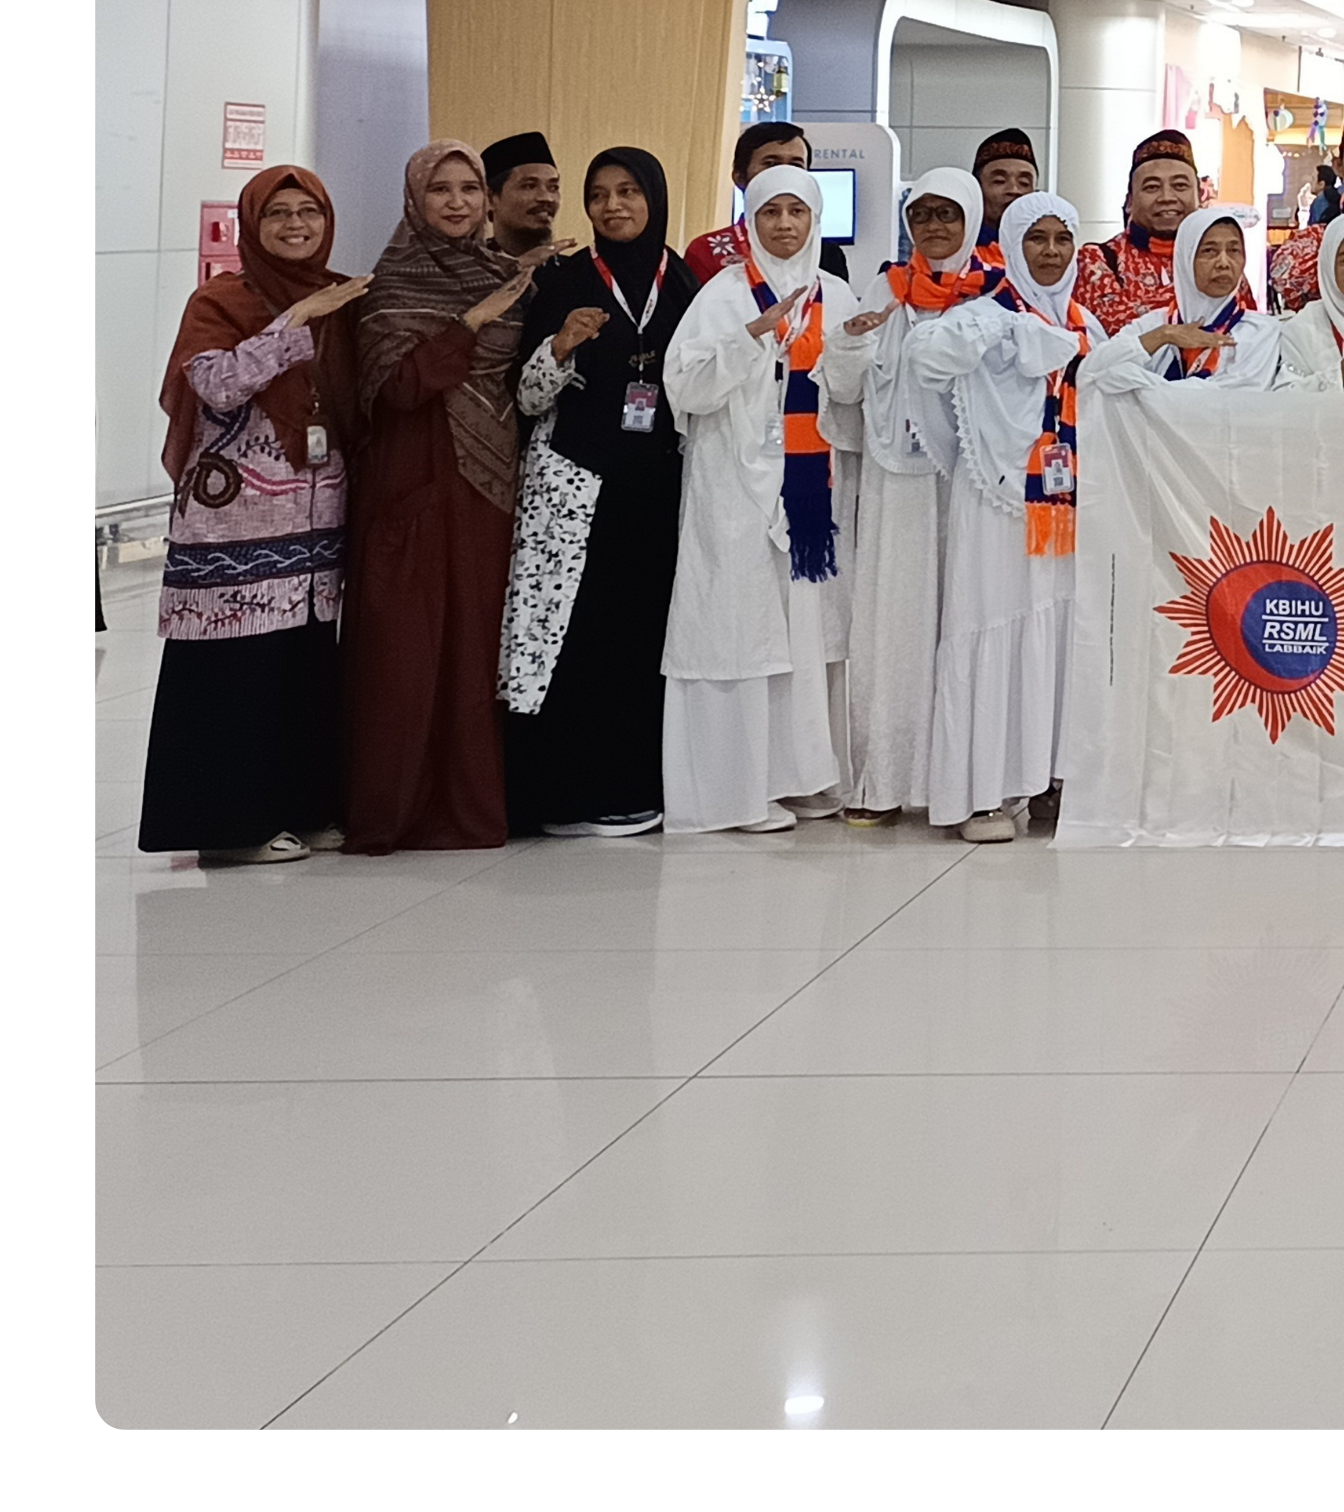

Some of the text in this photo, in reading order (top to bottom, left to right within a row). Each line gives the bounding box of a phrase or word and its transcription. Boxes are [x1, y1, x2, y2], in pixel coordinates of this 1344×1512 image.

[813, 149, 865, 159] RENTAL
[1265, 599, 1324, 616] KBIHU
[1263, 621, 1328, 641] RSML
[1265, 643, 1327, 655] LABBAIK
